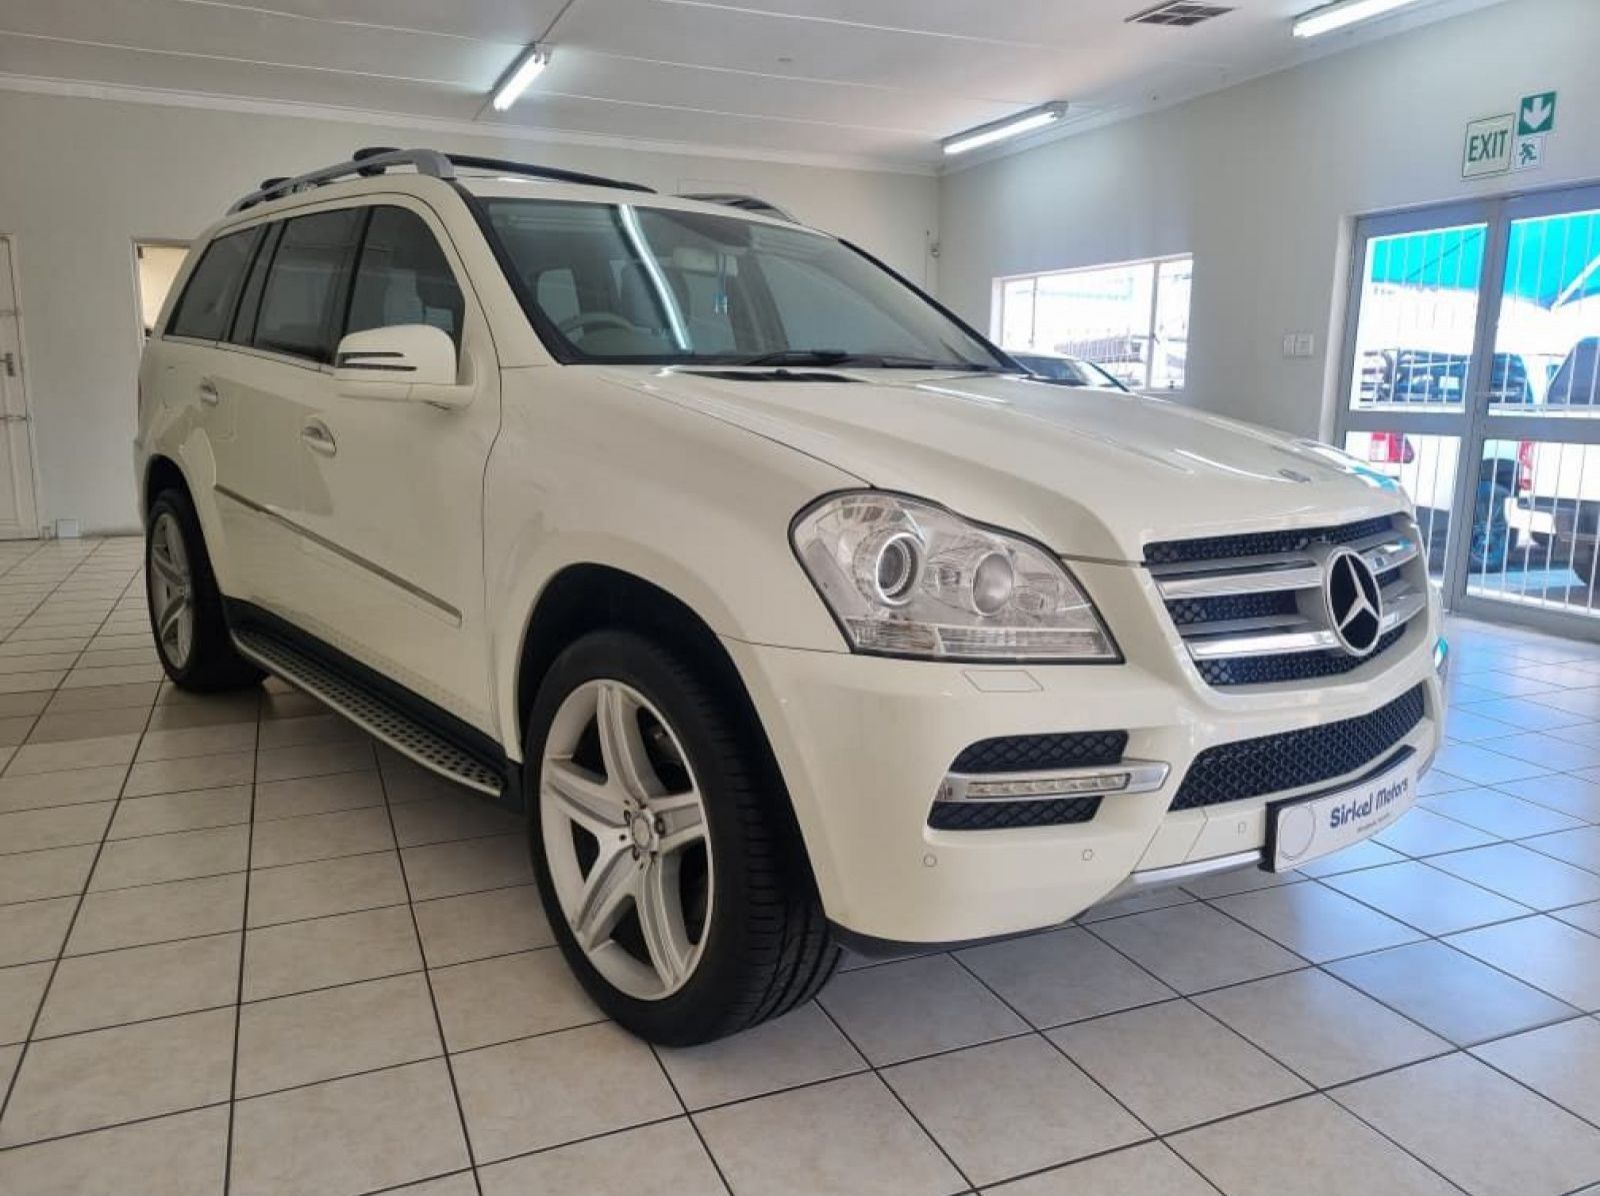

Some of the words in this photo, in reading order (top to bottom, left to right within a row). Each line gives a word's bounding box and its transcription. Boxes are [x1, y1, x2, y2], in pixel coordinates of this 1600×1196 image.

[1468, 130, 1509, 162] EXIT
[1330, 793, 1373, 828] Sirkel
[1375, 778, 1409, 810] Motors
